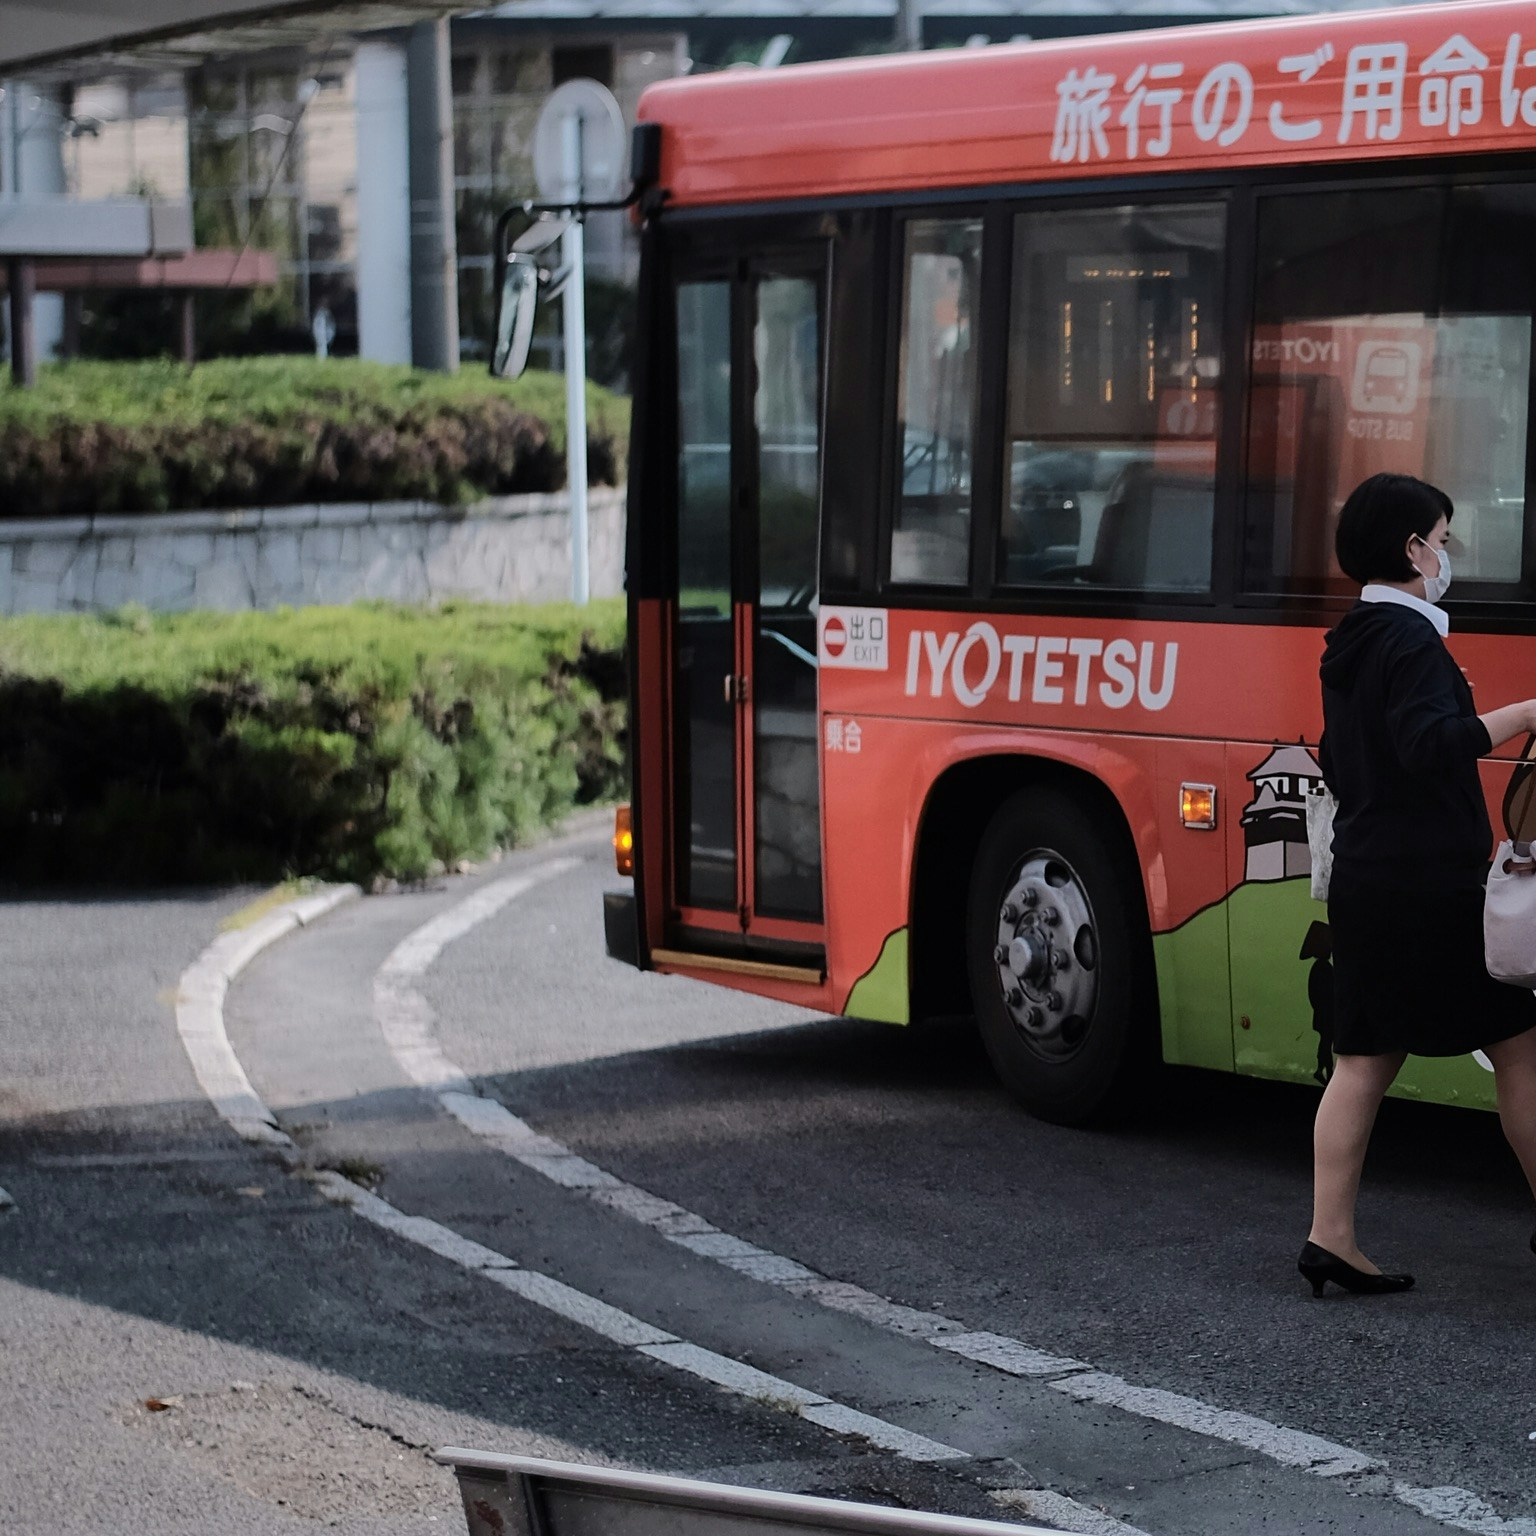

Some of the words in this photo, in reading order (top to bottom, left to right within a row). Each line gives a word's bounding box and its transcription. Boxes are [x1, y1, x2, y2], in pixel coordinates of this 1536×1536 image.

[850, 614, 883, 641] 出口
[854, 646, 880, 662] EXIT
[904, 620, 1178, 711] IYOTETSU
